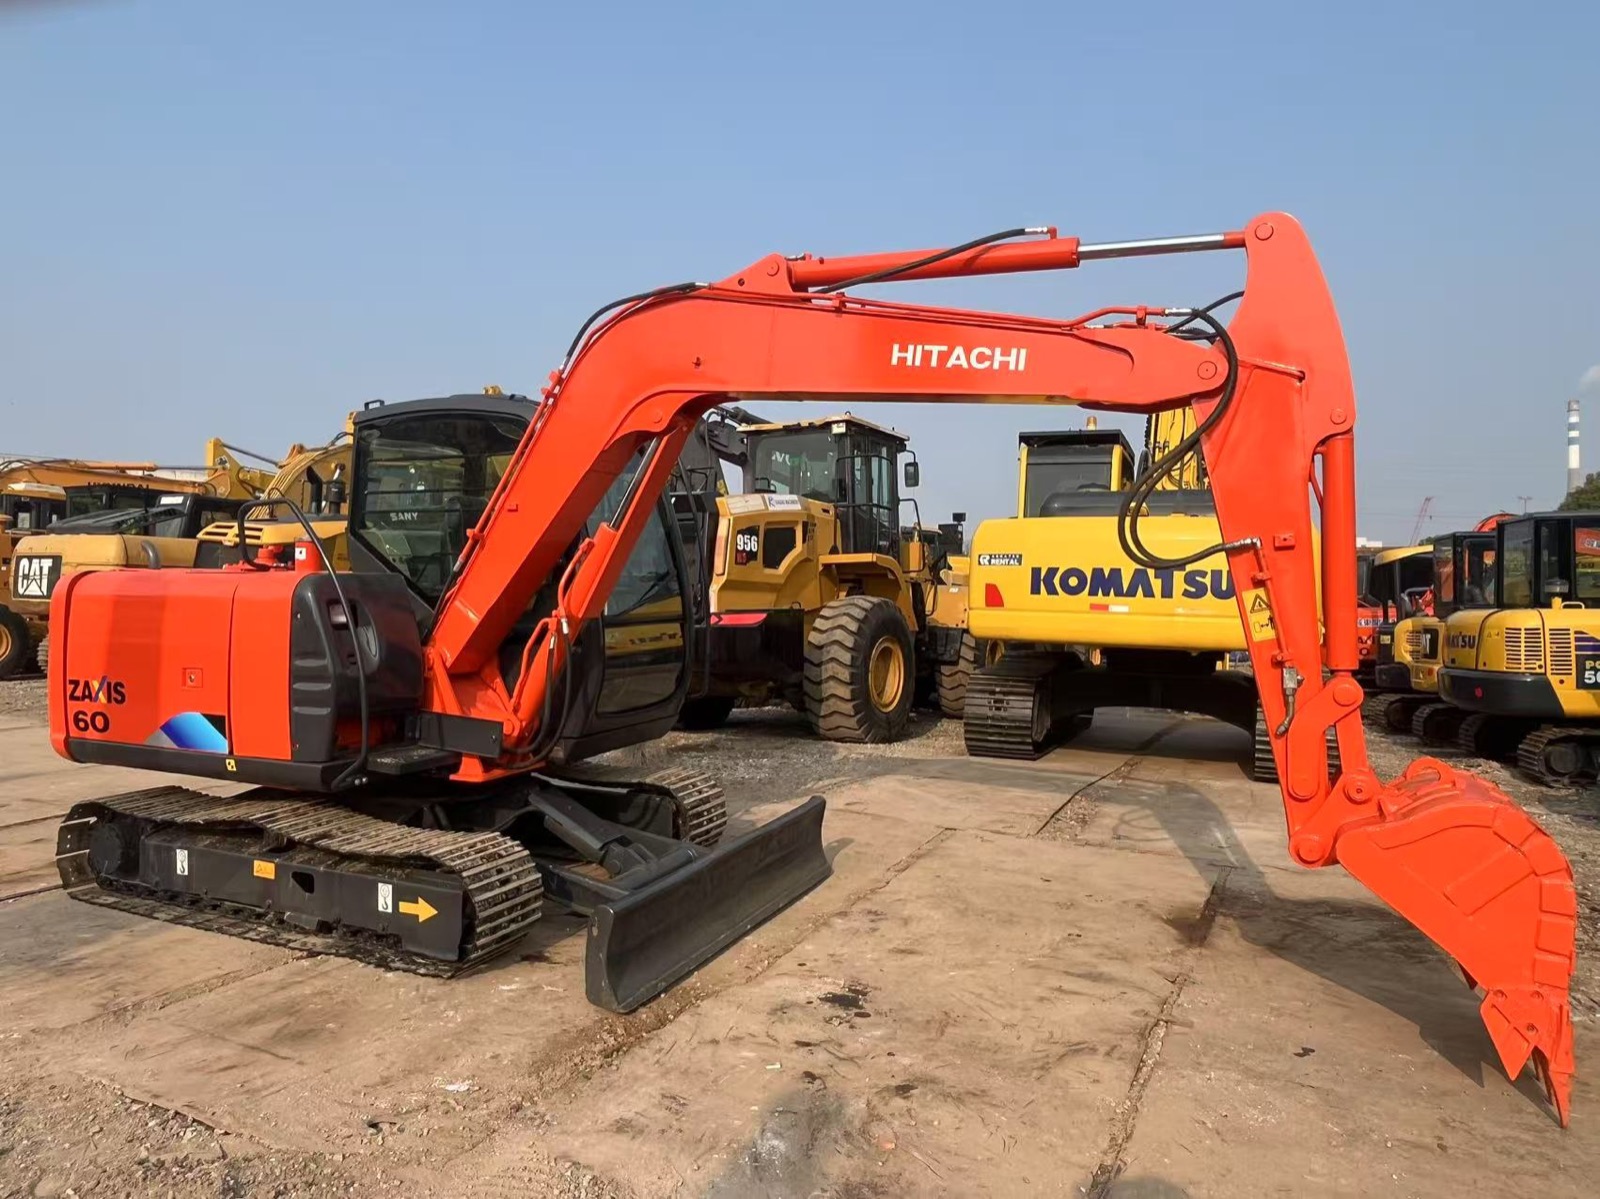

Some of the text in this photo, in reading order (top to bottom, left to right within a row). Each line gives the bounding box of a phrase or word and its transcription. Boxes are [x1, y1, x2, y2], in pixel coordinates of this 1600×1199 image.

[890, 343, 1027, 371] HITACHI
[390, 511, 418, 522] SANY
[736, 534, 758, 552] 956
[17, 557, 53, 597] CAT
[1030, 566, 1236, 600] KOMATSU
[68, 675, 126, 705] ZAXIS
[73, 710, 110, 733] 60
